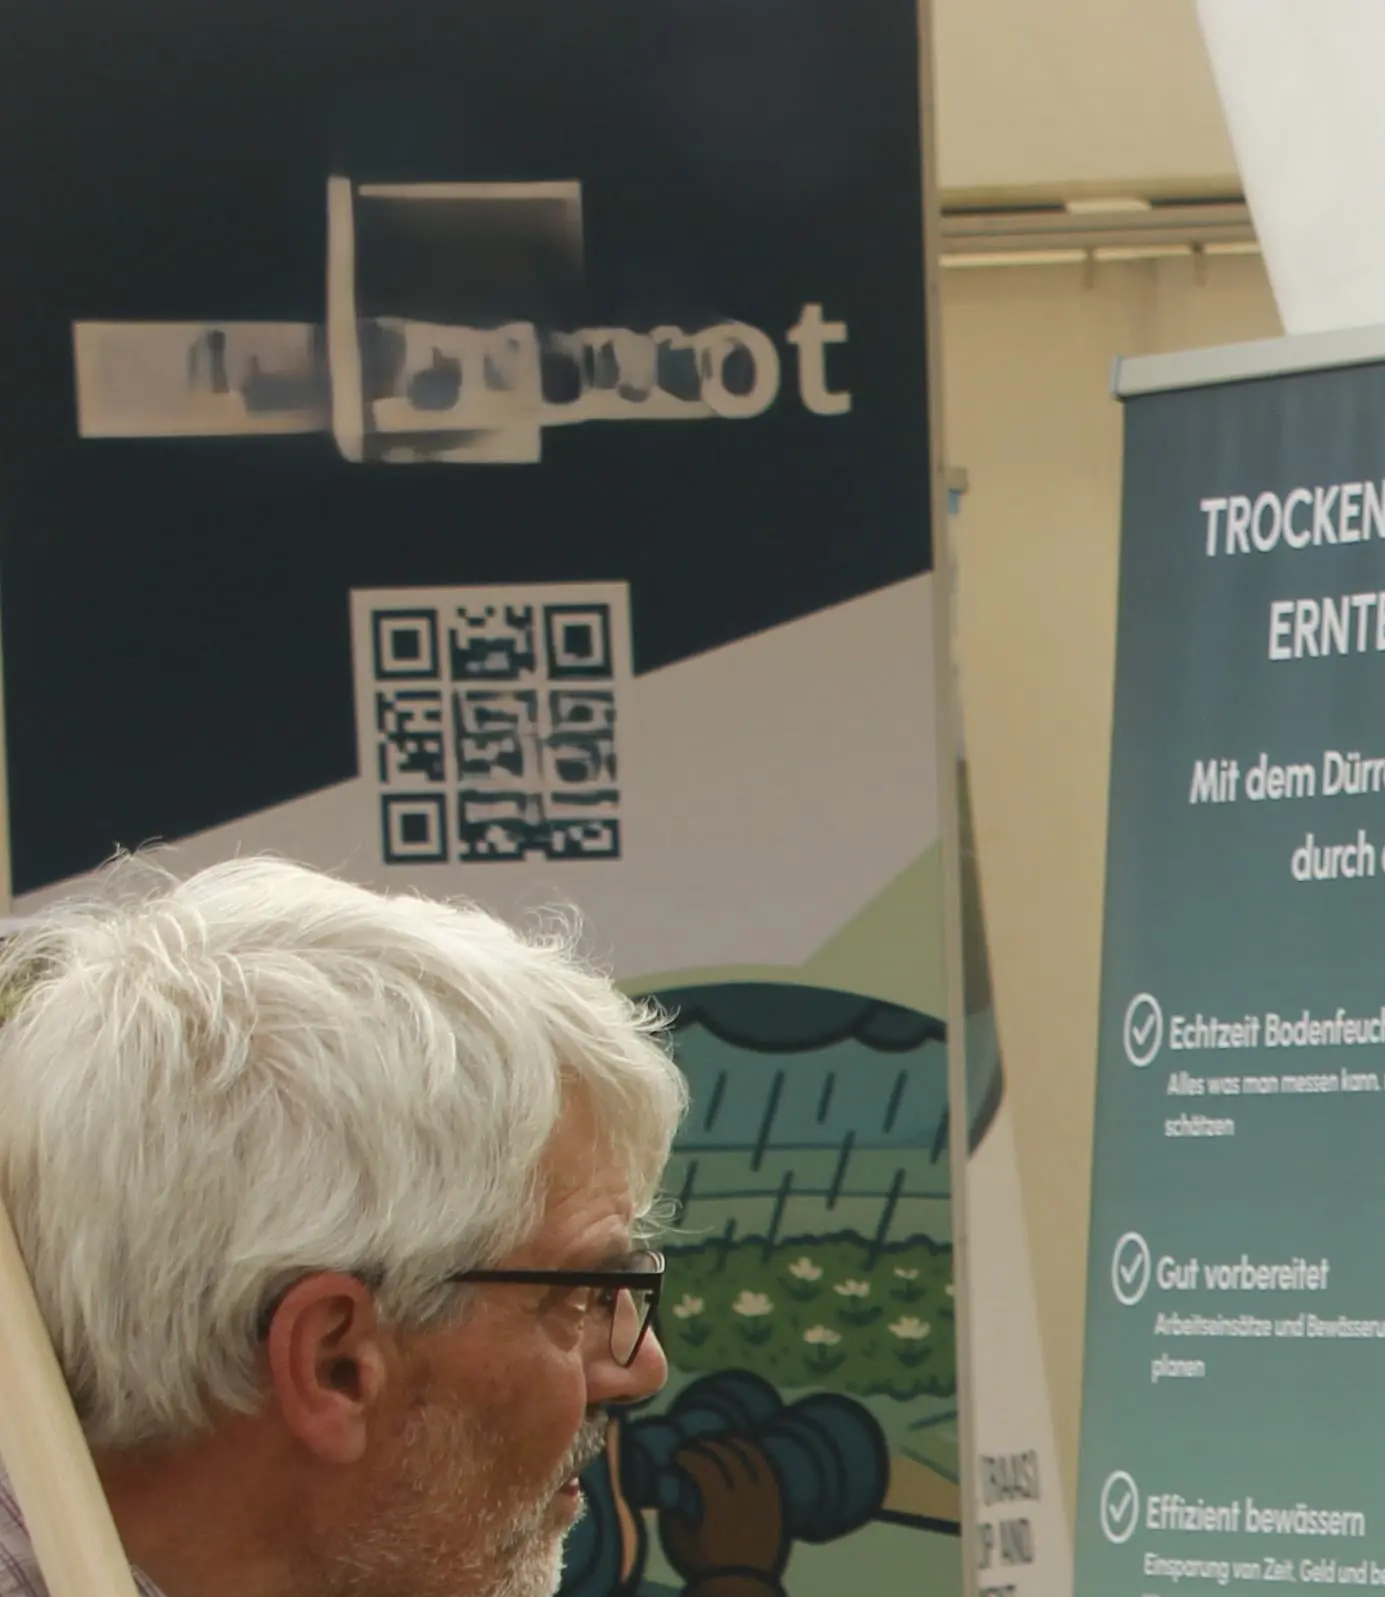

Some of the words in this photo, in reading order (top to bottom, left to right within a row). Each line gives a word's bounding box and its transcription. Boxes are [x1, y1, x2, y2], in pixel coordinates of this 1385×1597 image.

[1189, 757, 1240, 804] Mit
[1245, 753, 1315, 801] dem
[1291, 829, 1376, 881] durch
[1169, 1013, 1261, 1051] Echtzeit
[1167, 1071, 1205, 1098] Alles
[1208, 1077, 1240, 1097] was
[1242, 1075, 1279, 1096] man
[1281, 1074, 1338, 1096] messen
[1164, 1113, 1235, 1140] schätzen
[1156, 1257, 1199, 1292] Gut
[1203, 1255, 1330, 1291] vorbereitet
[1275, 1311, 1305, 1339] und
[1151, 1353, 1206, 1384] planen
[1146, 1494, 1241, 1533] Effizient
[1245, 1497, 1366, 1538] bewässern
[1143, 1552, 1230, 1586] Einsparung
[1300, 1558, 1337, 1584] Geld
[1338, 1559, 1368, 1586] und
